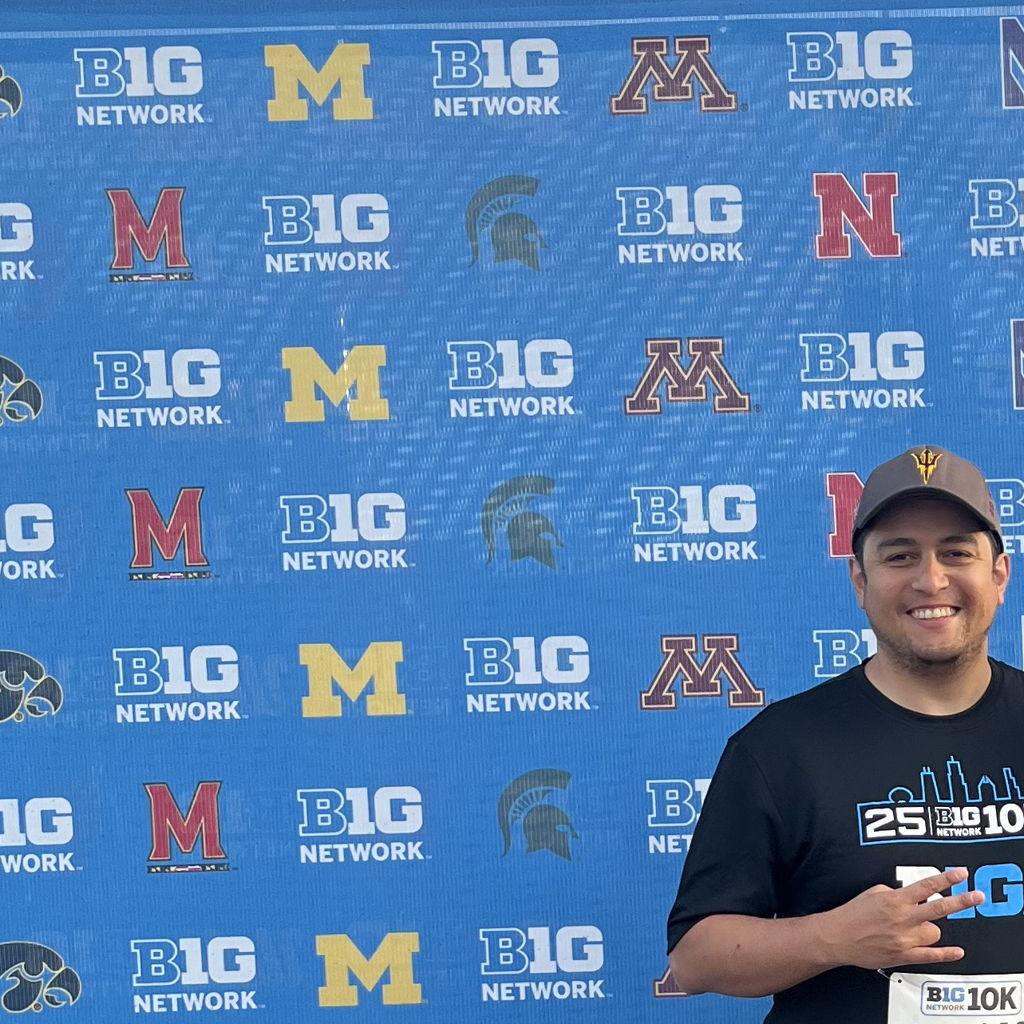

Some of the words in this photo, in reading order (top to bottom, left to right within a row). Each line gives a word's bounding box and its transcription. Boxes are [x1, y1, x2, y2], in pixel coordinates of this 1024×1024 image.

[263, 42, 376, 123] M
[610, 35, 738, 114] M
[435, 96, 560, 116] NETWORK
[789, 88, 913, 109] NETWORK
[77, 104, 204, 125] NETWORK
[811, 171, 903, 261] N
[106, 186, 190, 271] M
[266, 251, 390, 273] NETWORK
[619, 243, 744, 263] NETWORK
[281, 344, 392, 423] M
[624, 337, 752, 416] M
[450, 396, 574, 417] NETWORK
[802, 389, 924, 410] NETWORK
[97, 406, 223, 427] NETWORK
[125, 487, 208, 569] M
[283, 549, 407, 570] NETWORK
[634, 541, 757, 561] NETWORK
[298, 641, 408, 718] M
[640, 634, 764, 710] M
[117, 701, 240, 722] NETWORK
[467, 692, 590, 712] NETWORK
[144, 780, 226, 862] M
[865, 807, 926, 838] 25
[936, 827, 982, 837] NETWORK
[0, 853, 75, 873] WORK
[300, 842, 423, 863] NETWORK
[315, 931, 424, 1008] M
[482, 981, 604, 1000] NETWORK
[968, 987, 1017, 1011] 10K
[134, 992, 257, 1012] NETWORK
